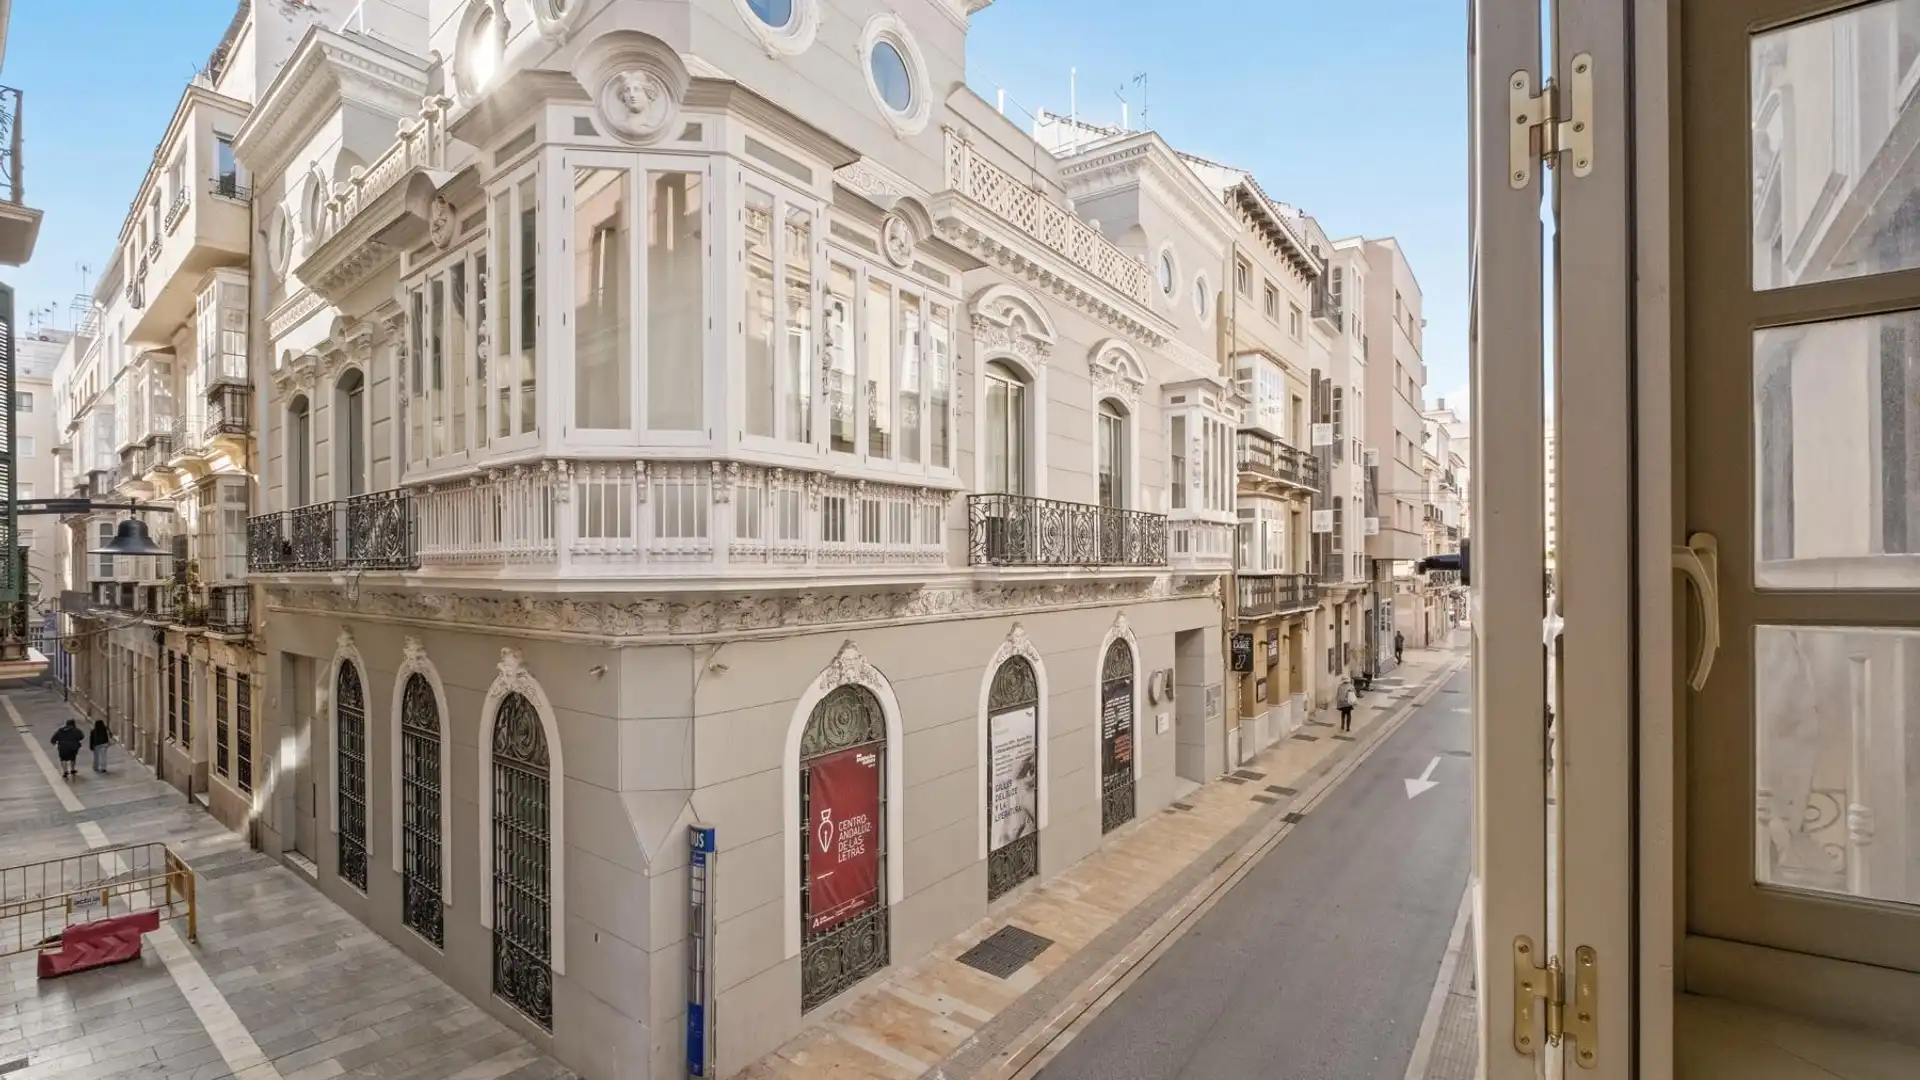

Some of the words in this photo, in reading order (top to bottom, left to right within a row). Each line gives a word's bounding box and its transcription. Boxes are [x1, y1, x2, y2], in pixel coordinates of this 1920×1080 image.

[838, 814, 867, 832] CENTRO
[838, 822, 871, 842] ANDALUZ
[838, 840, 849, 852] DE
[849, 834, 865, 849] LAS
[838, 844, 866, 863] LETRAS
